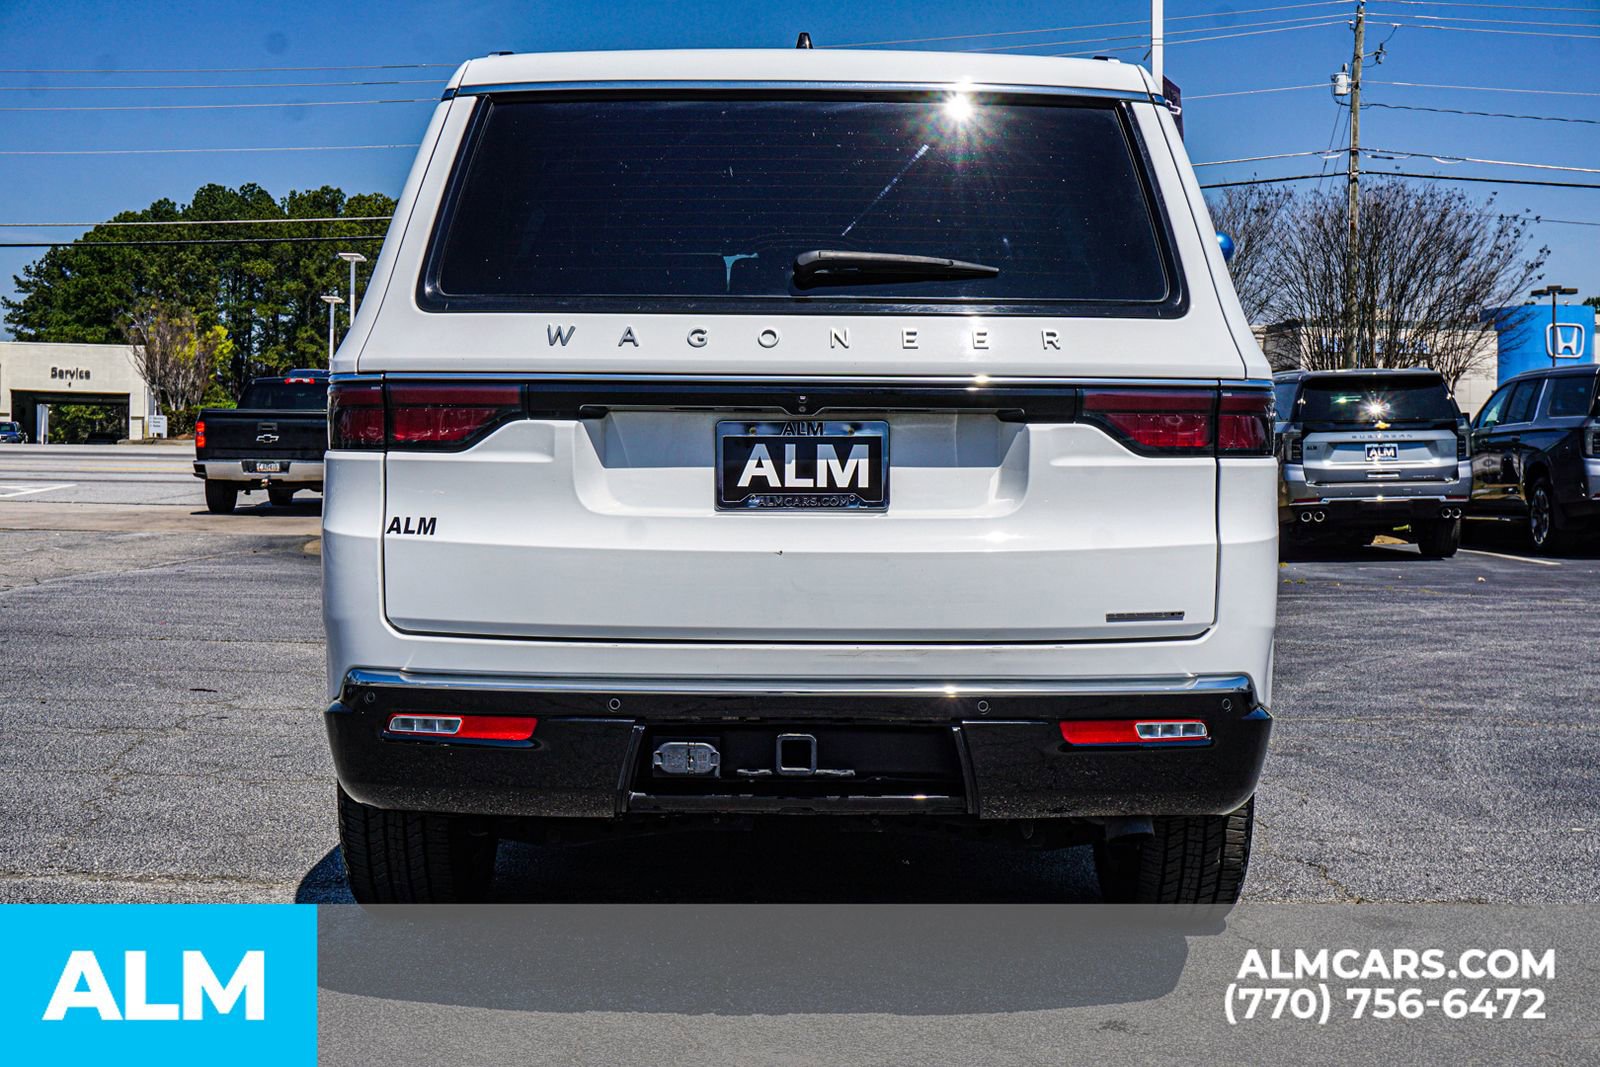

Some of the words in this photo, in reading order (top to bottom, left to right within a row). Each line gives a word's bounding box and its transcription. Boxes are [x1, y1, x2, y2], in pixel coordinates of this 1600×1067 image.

[546, 323, 1062, 351] WAGONEER
[50, 366, 91, 380] Service
[780, 421, 825, 436] ALM
[1369, 448, 1395, 457] ALM
[736, 443, 870, 489] ALM
[758, 495, 850, 507] ALMCARS.COM
[386, 516, 437, 535] ALM
